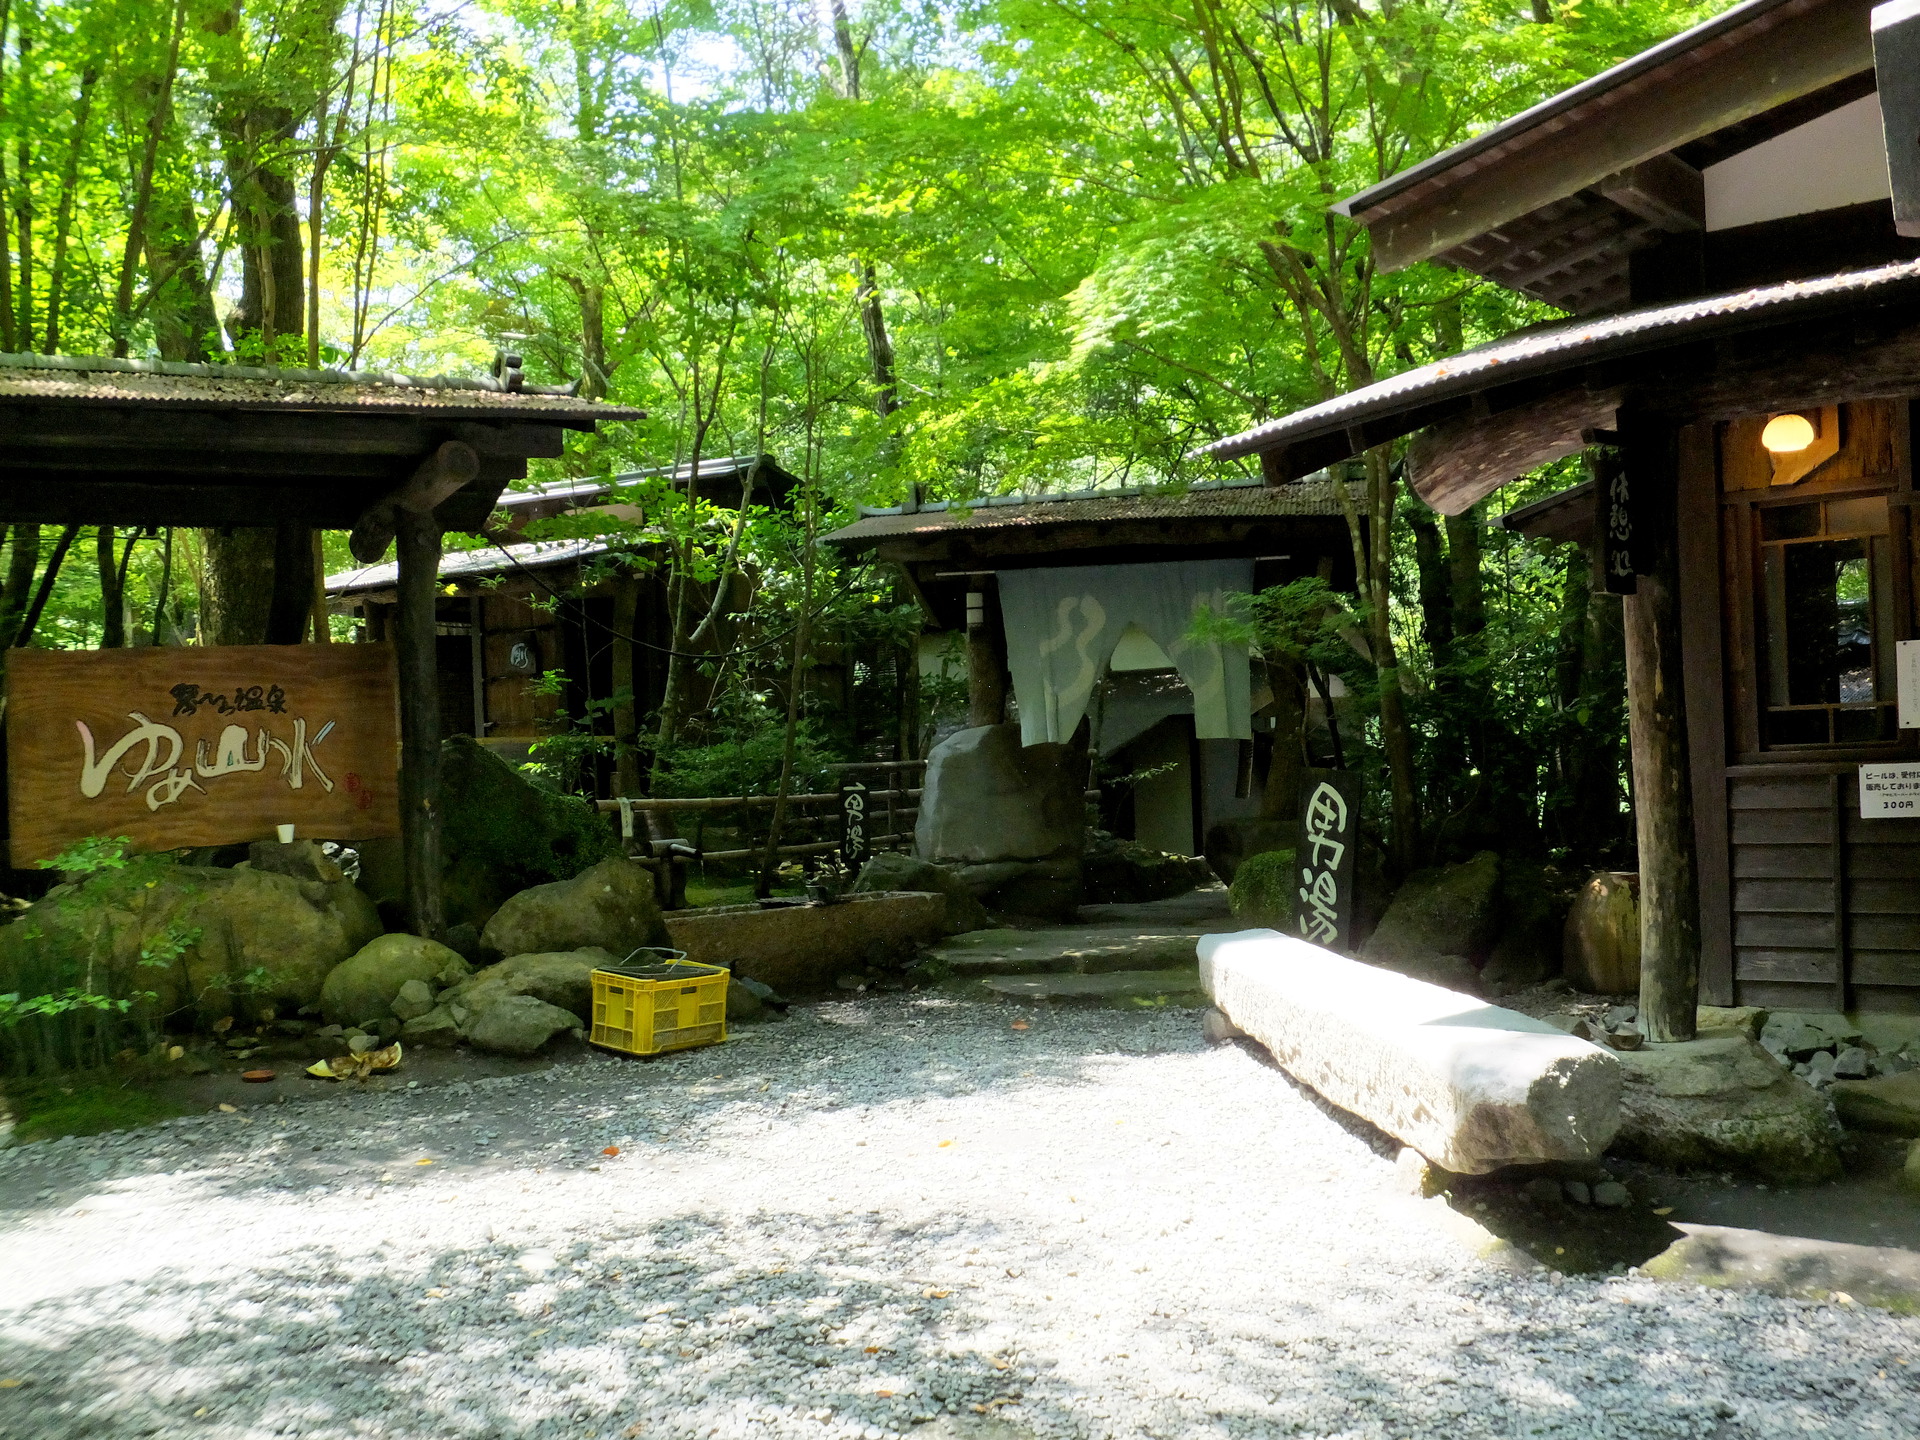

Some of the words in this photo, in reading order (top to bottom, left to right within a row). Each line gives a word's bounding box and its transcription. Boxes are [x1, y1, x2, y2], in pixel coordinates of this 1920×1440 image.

[75, 709, 336, 811] ゆめ山水
[843, 793, 865, 859] 男湯
[1883, 801, 1914, 809] 300円
[1299, 781, 1348, 945] 男湯
